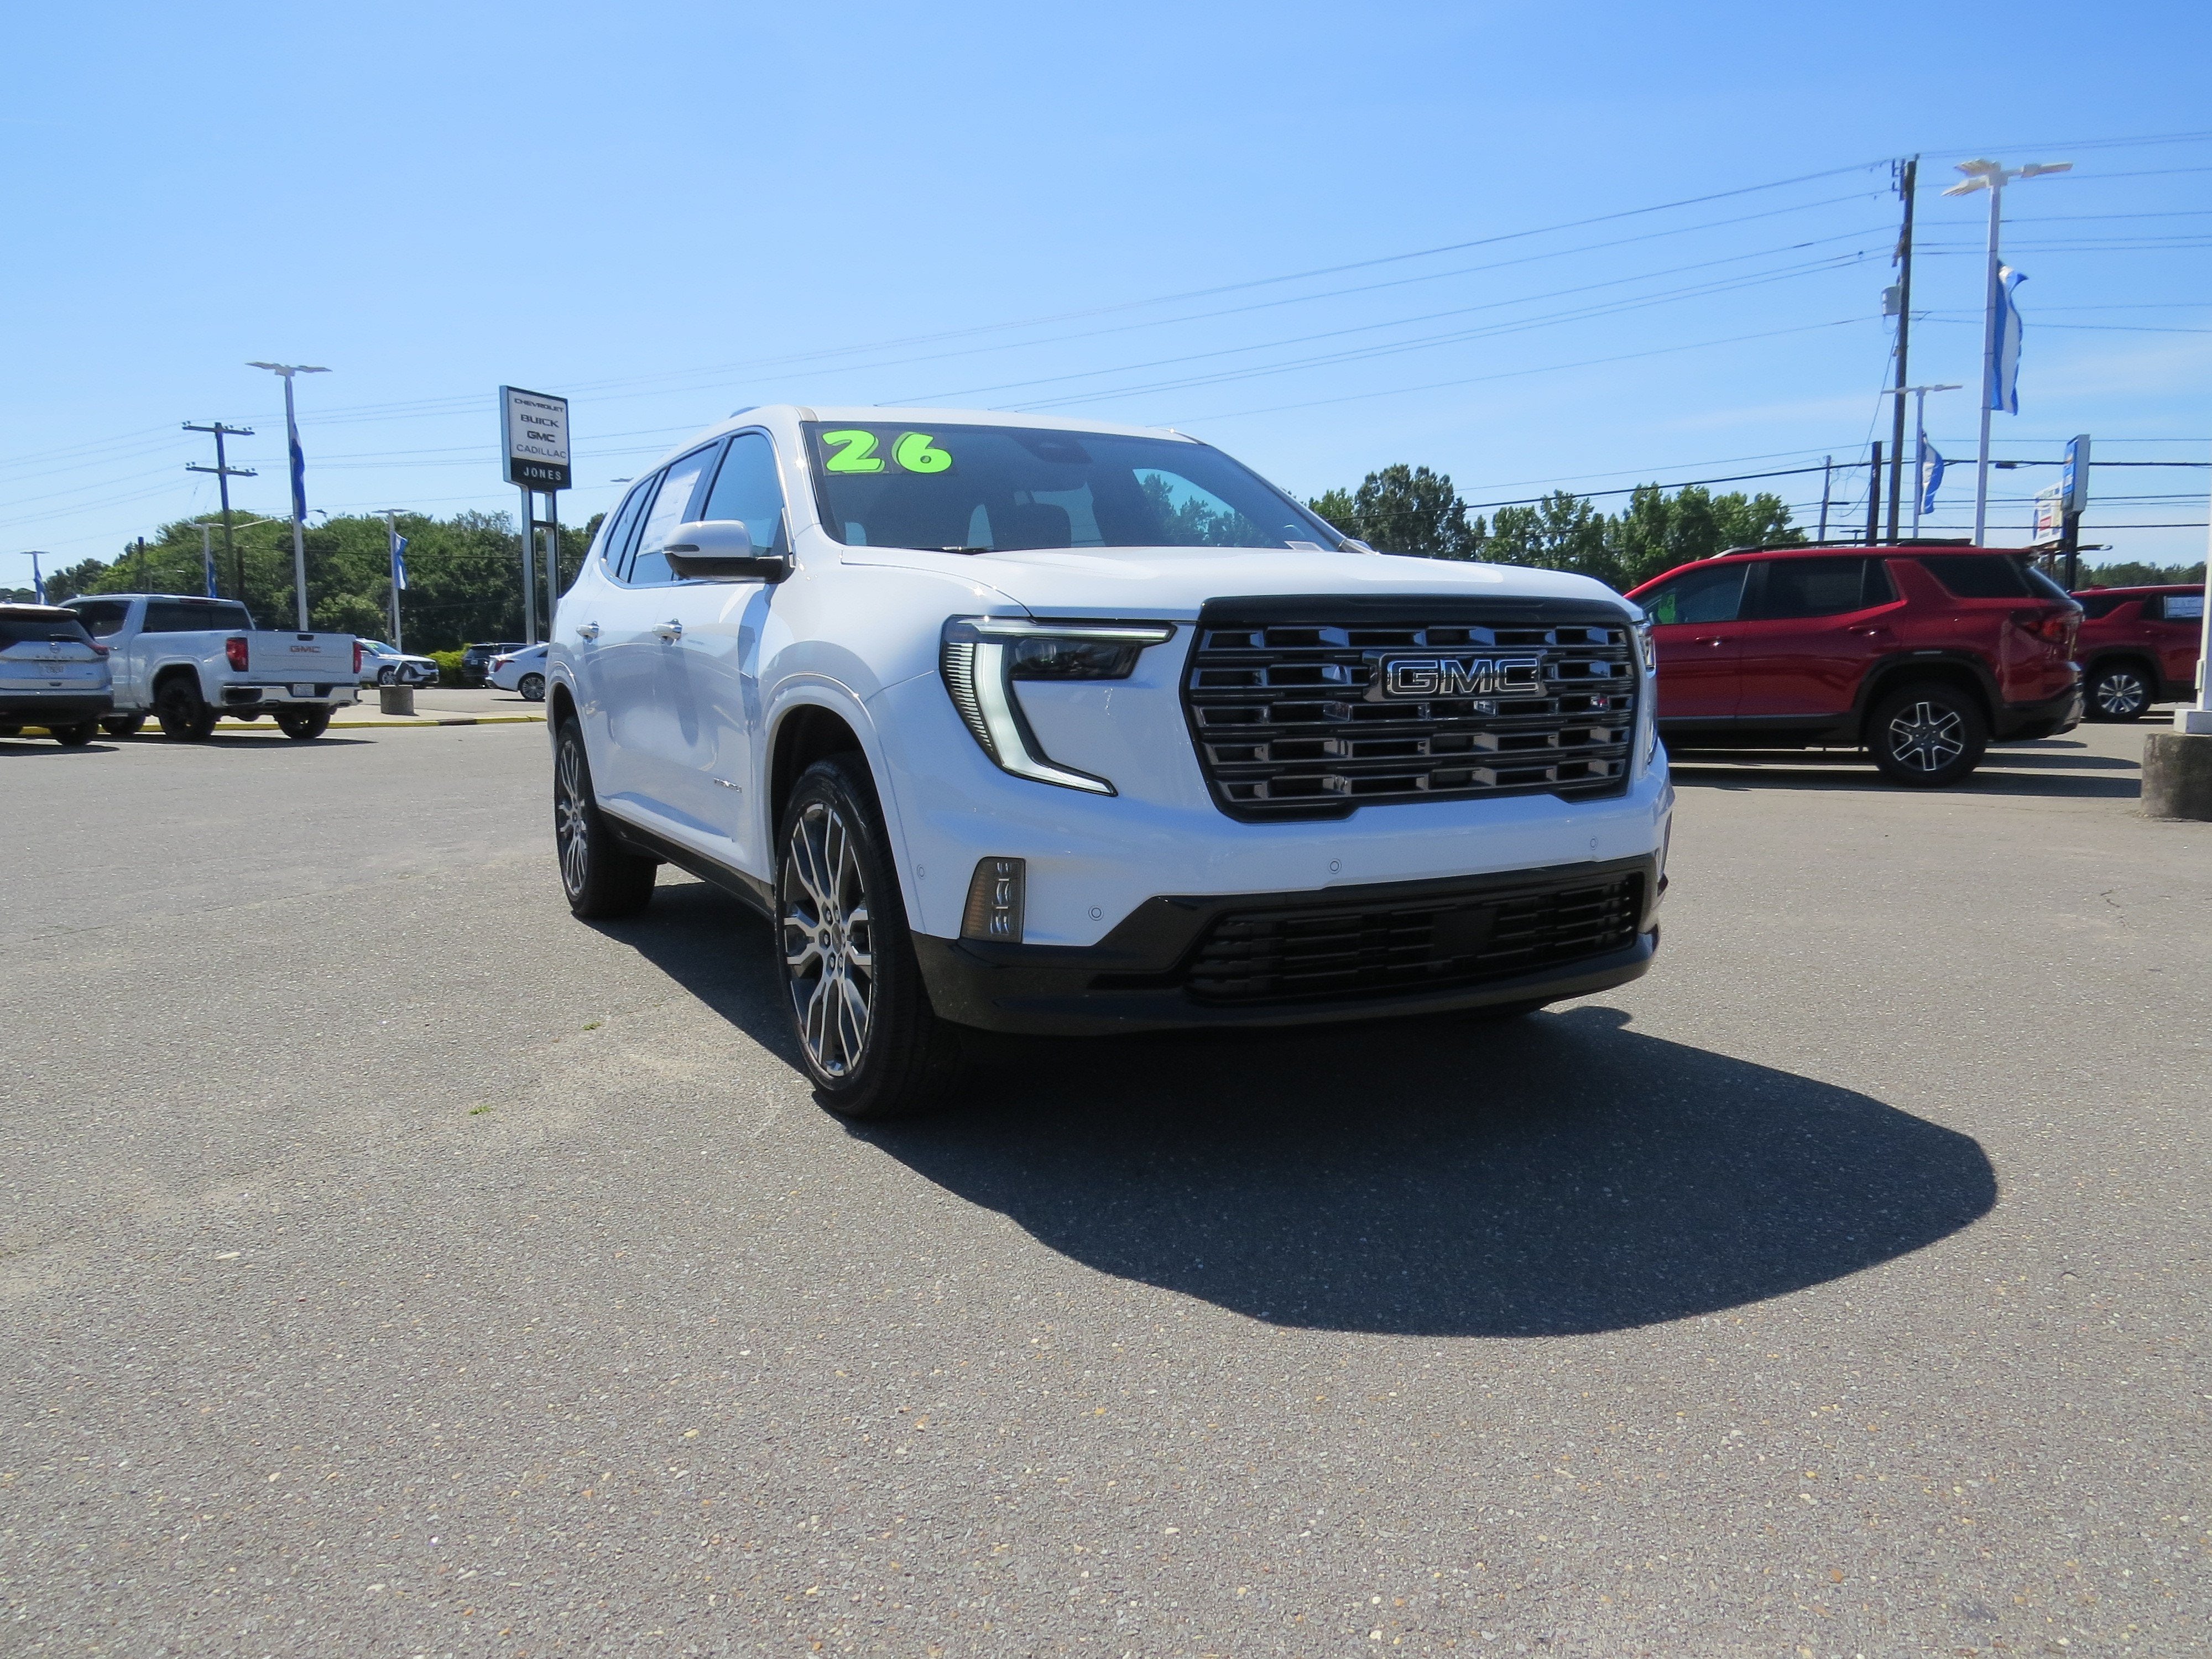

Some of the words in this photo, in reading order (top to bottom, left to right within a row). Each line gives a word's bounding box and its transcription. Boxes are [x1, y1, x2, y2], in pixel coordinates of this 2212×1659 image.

[514, 398, 564, 413] CHEVROLET
[520, 414, 560, 427] BUICK
[527, 430, 555, 443] GMC
[516, 444, 567, 458] CADILLAC
[822, 429, 953, 474] 26
[523, 467, 561, 480] JONES
[1387, 658, 1539, 695] GMC
